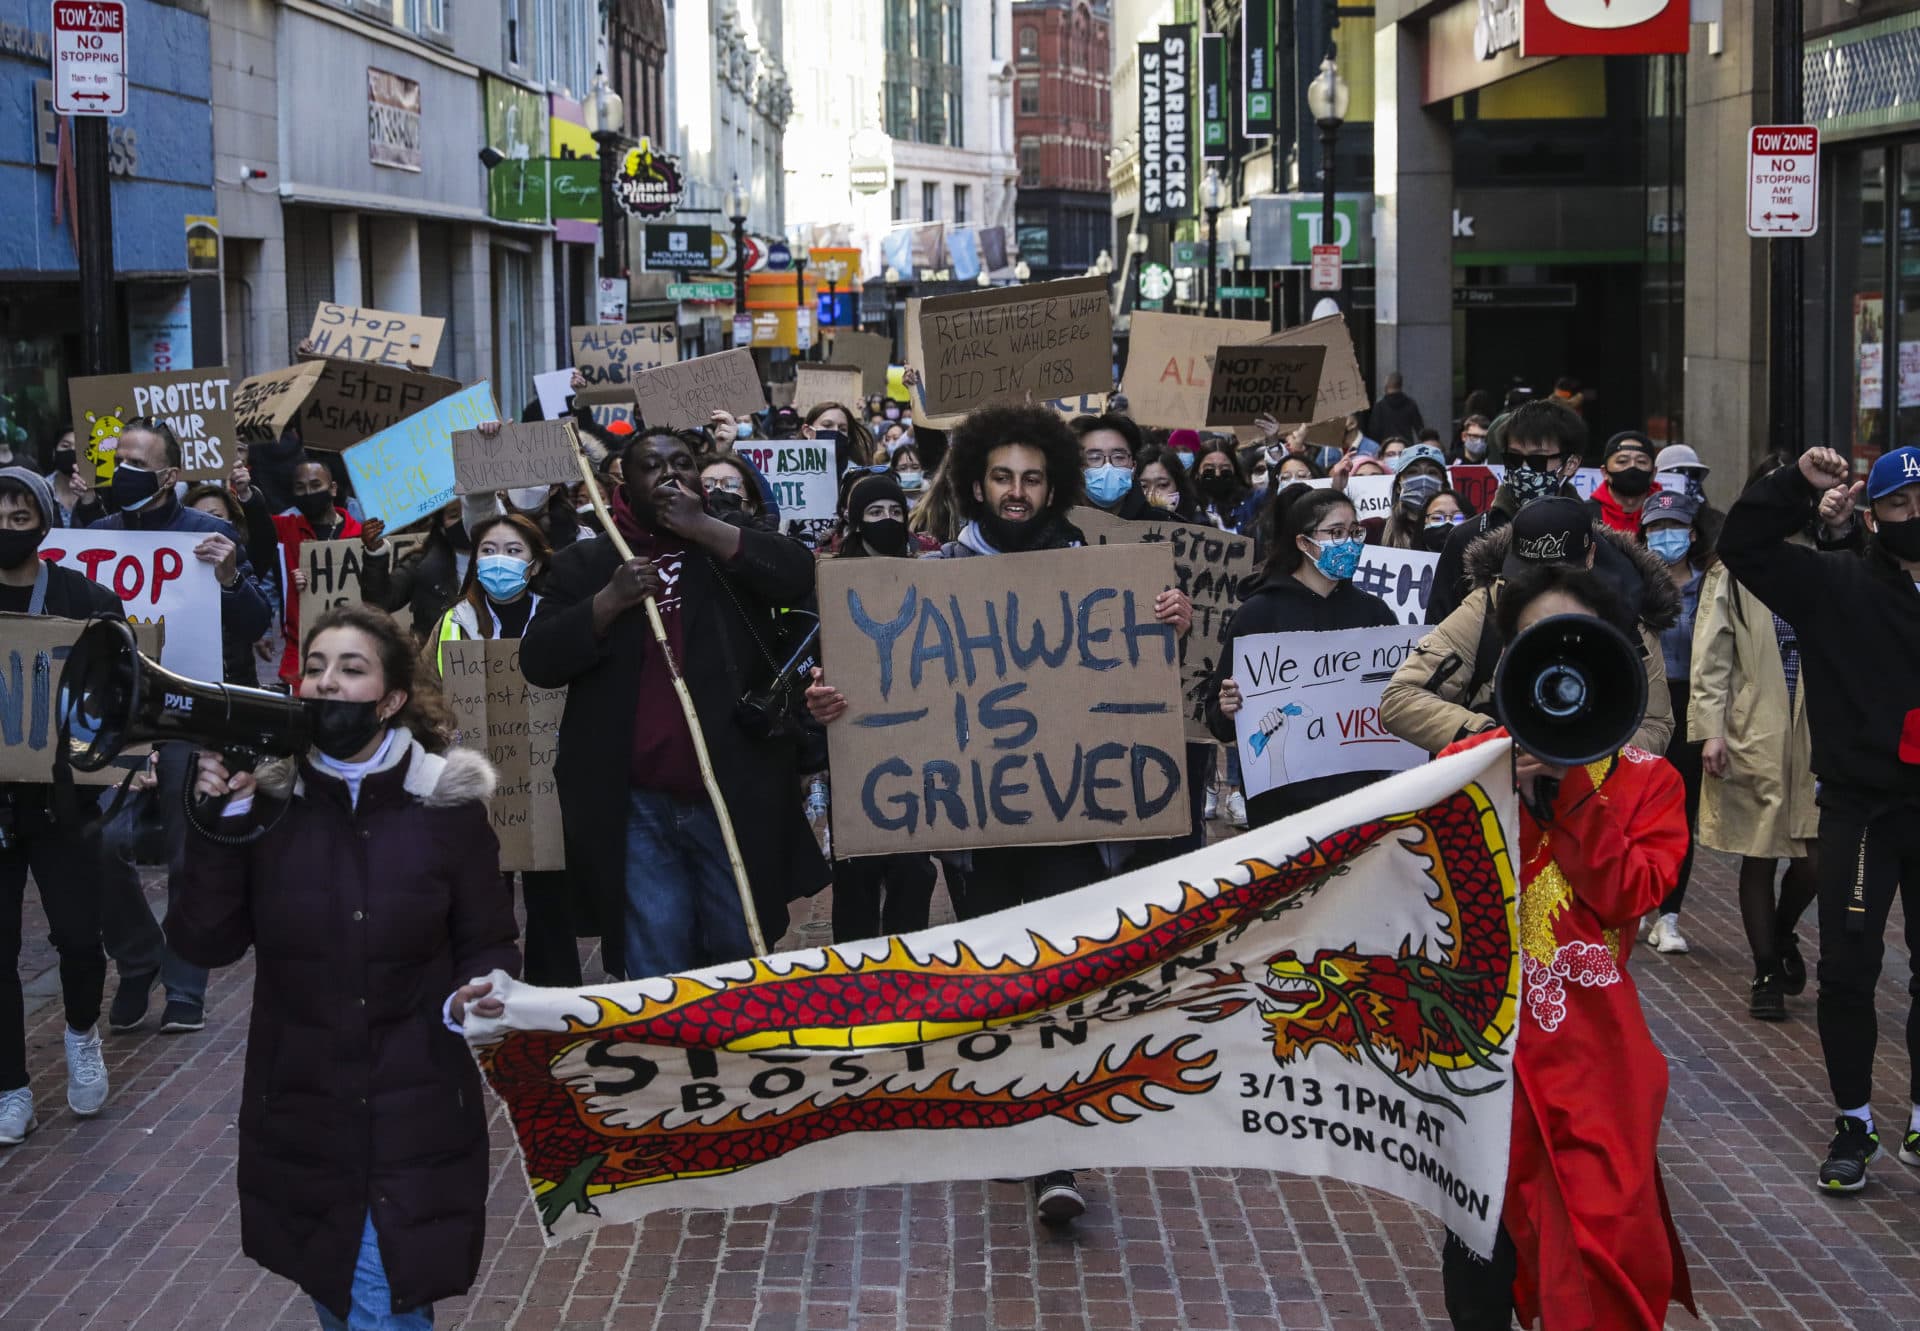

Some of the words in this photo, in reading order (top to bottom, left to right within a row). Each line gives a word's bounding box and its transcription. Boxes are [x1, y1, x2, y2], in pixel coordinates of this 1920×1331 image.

[59, 8, 86, 26] TOW
[89, 9, 120, 28] ZONE
[61, 51, 119, 64] STOPPING
[77, 35, 104, 50] NO
[1251, 47, 1264, 89] Bank
[1207, 83, 1218, 119] Bank
[1143, 53, 1161, 214] STARBUCKS
[1164, 37, 1187, 209] STARBUCKS
[1756, 134, 1780, 151] TOW
[1783, 134, 1813, 151] ZONE
[1756, 174, 1811, 185] STOPPING
[1771, 159, 1796, 172] NO
[623, 181, 668, 197] planet
[628, 191, 679, 204] fitness
[1771, 195, 1793, 205] TIME
[1772, 186, 1793, 195] ANY
[1297, 211, 1352, 250] TD
[580, 330, 616, 351] ALL
[620, 326, 646, 346] OF
[651, 324, 675, 344] US
[935, 299, 1058, 344] REMEMBER
[1069, 296, 1103, 320] WHAT
[312, 328, 408, 365] HATE
[940, 339, 998, 369] MARK
[1009, 324, 1090, 355] WAHLBERG
[634, 366, 680, 398] END
[692, 353, 745, 386] WHITE
[939, 369, 984, 402] DID
[993, 362, 1025, 393] IN
[1038, 358, 1074, 390] 1988
[1218, 358, 1263, 376] NOT
[133, 379, 230, 418] PROTECT
[670, 375, 751, 411] SUPREMACY
[1226, 376, 1298, 394] MODEL
[306, 399, 377, 434] ASIAN
[1211, 393, 1314, 415] MINORITY
[454, 430, 504, 458] END
[512, 422, 573, 454] WHITE
[350, 436, 399, 482] WE
[460, 455, 552, 491] SUPREMACY
[776, 447, 828, 473] ASIAN
[373, 459, 442, 522] HERE
[847, 583, 1176, 702] YAHWEH
[449, 648, 504, 680] Hate
[797, 655, 815, 676] PYLE
[1244, 645, 1299, 688] We
[1313, 650, 1361, 679] are
[1372, 638, 1416, 669] not
[165, 692, 194, 711] PYLE
[451, 685, 514, 714] Against
[954, 682, 1038, 752] IS
[488, 716, 559, 738] increased
[1306, 716, 1325, 741] a
[861, 741, 1181, 836] GRIEVED
[492, 808, 527, 827] New
[1239, 1072, 1323, 1107] 3/13
[1334, 1083, 1407, 1129] 1PM
[1415, 1110, 1446, 1147] AT
[1242, 1108, 1376, 1154] BOSTON
[1380, 1136, 1490, 1222] COMMON
